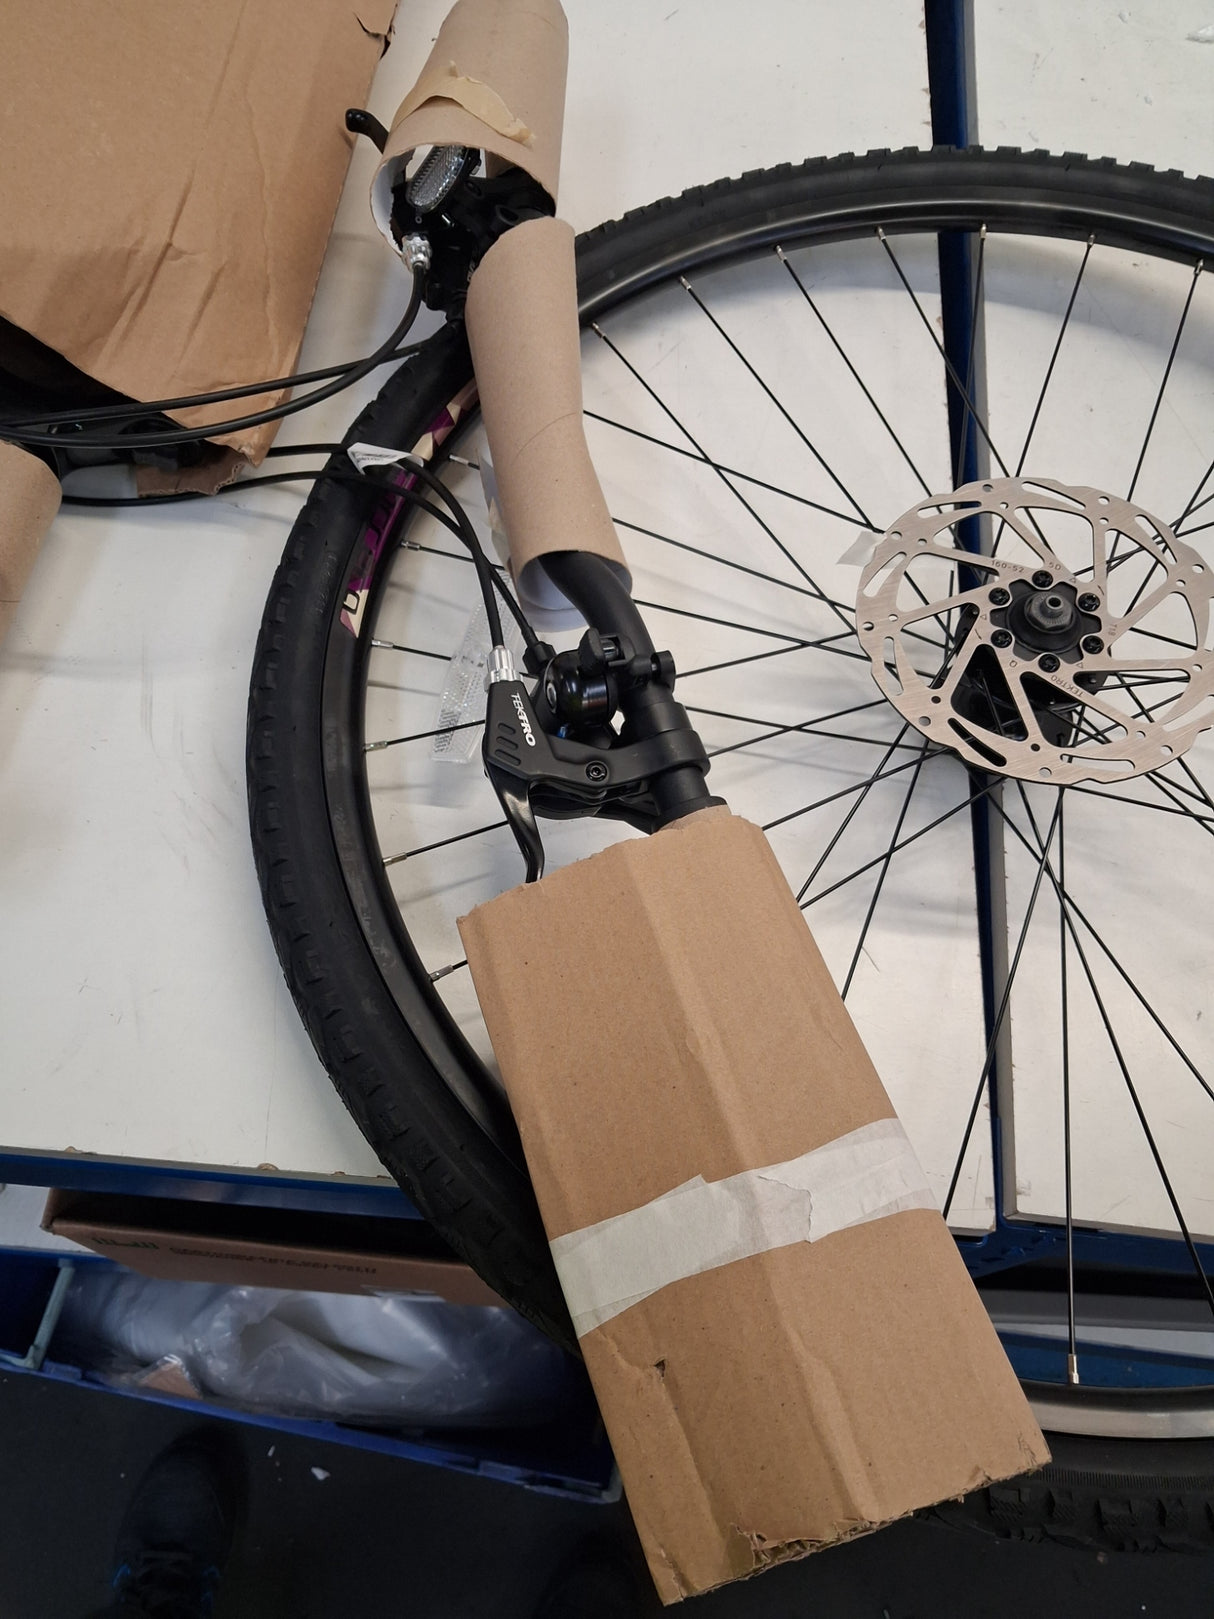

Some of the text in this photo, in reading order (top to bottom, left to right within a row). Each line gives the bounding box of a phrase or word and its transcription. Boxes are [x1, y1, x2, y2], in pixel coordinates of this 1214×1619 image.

[991, 560, 1025, 573] 160-52
[1050, 674, 1084, 698] TEKTRO
[510, 692, 536, 747] TEKTRO
